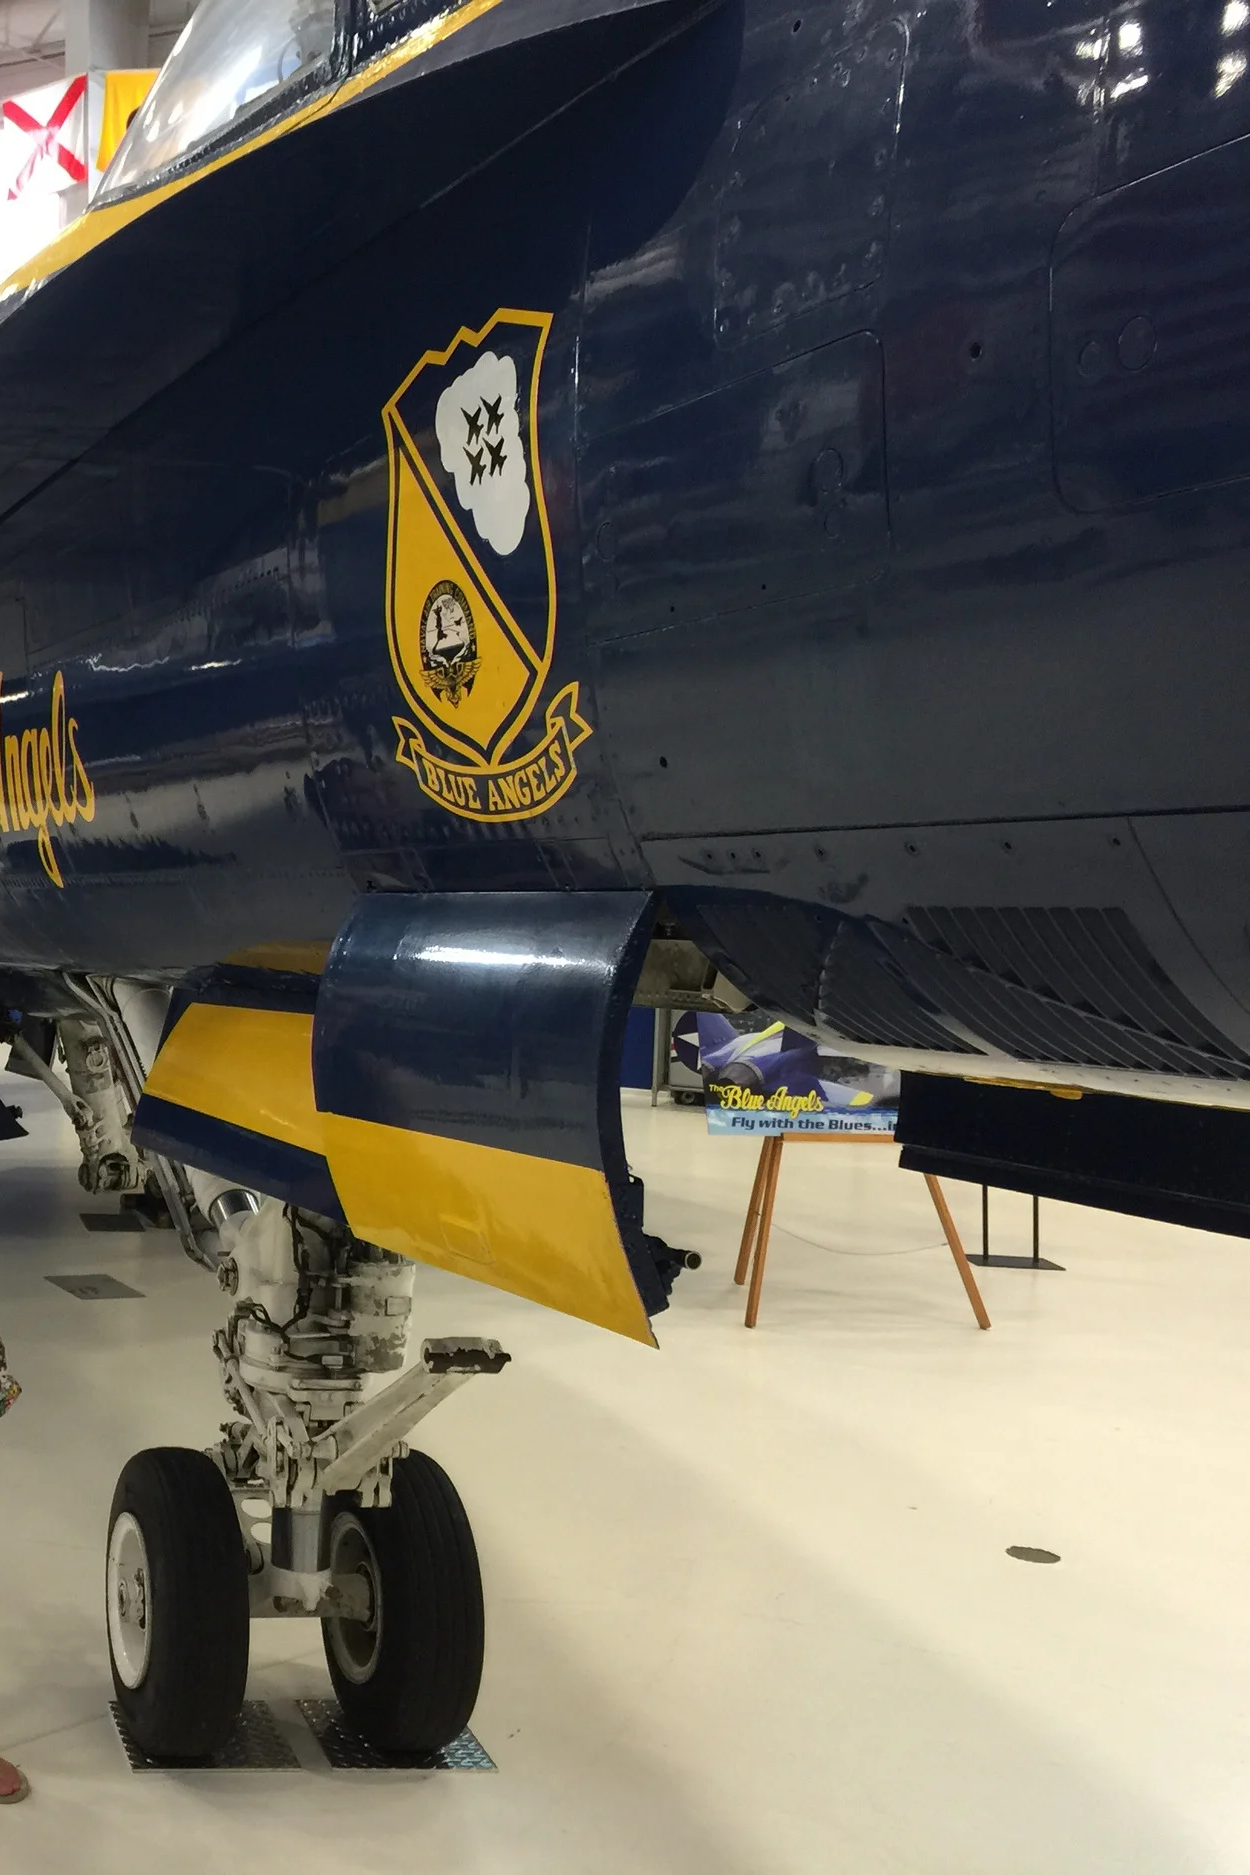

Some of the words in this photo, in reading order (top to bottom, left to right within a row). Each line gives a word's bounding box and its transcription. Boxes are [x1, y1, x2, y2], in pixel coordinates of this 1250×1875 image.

[422, 758, 481, 809] BLUE
[488, 739, 566, 811] ANGELS
[709, 1084, 724, 1093] The
[720, 1085, 765, 1110] Blue
[766, 1086, 824, 1119] Angels
[731, 1117, 755, 1130] Fly
[759, 1118, 794, 1129] with
[798, 1119, 825, 1130] the
